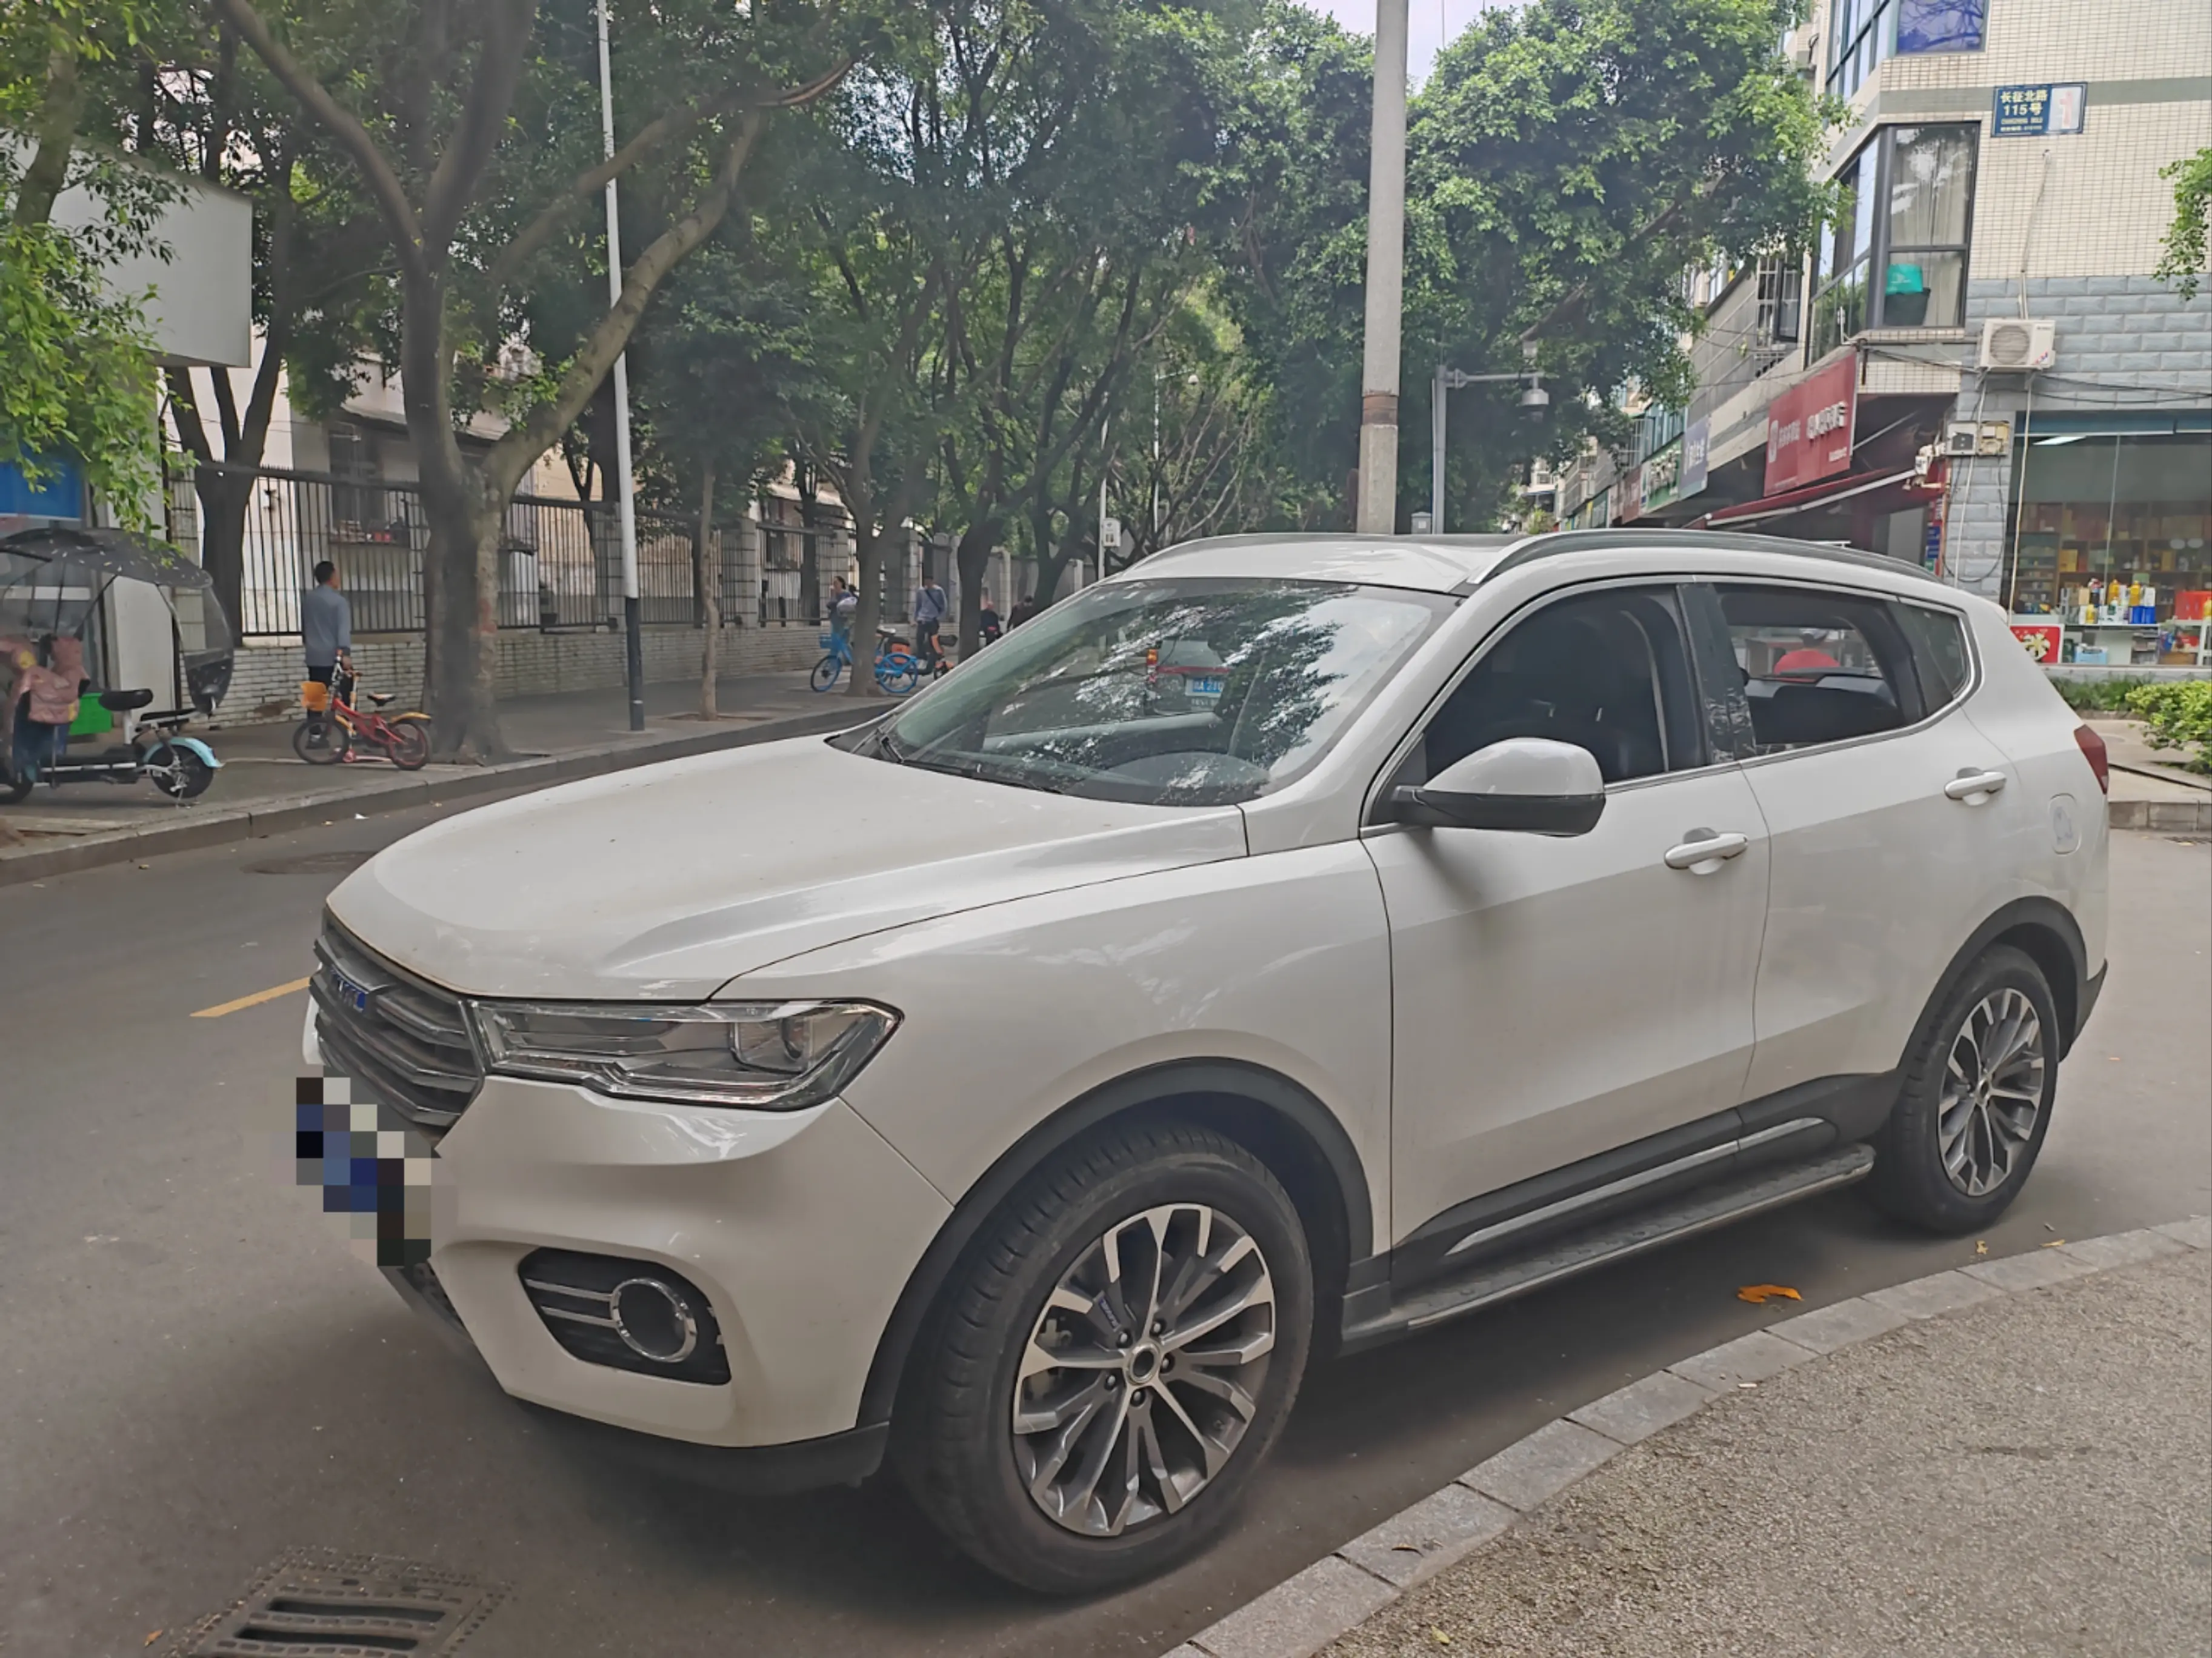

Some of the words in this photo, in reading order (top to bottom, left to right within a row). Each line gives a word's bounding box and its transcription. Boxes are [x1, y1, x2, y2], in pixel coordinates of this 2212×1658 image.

[2000, 90, 2048, 103] 长征北路
[2004, 102, 2043, 116] 115号
